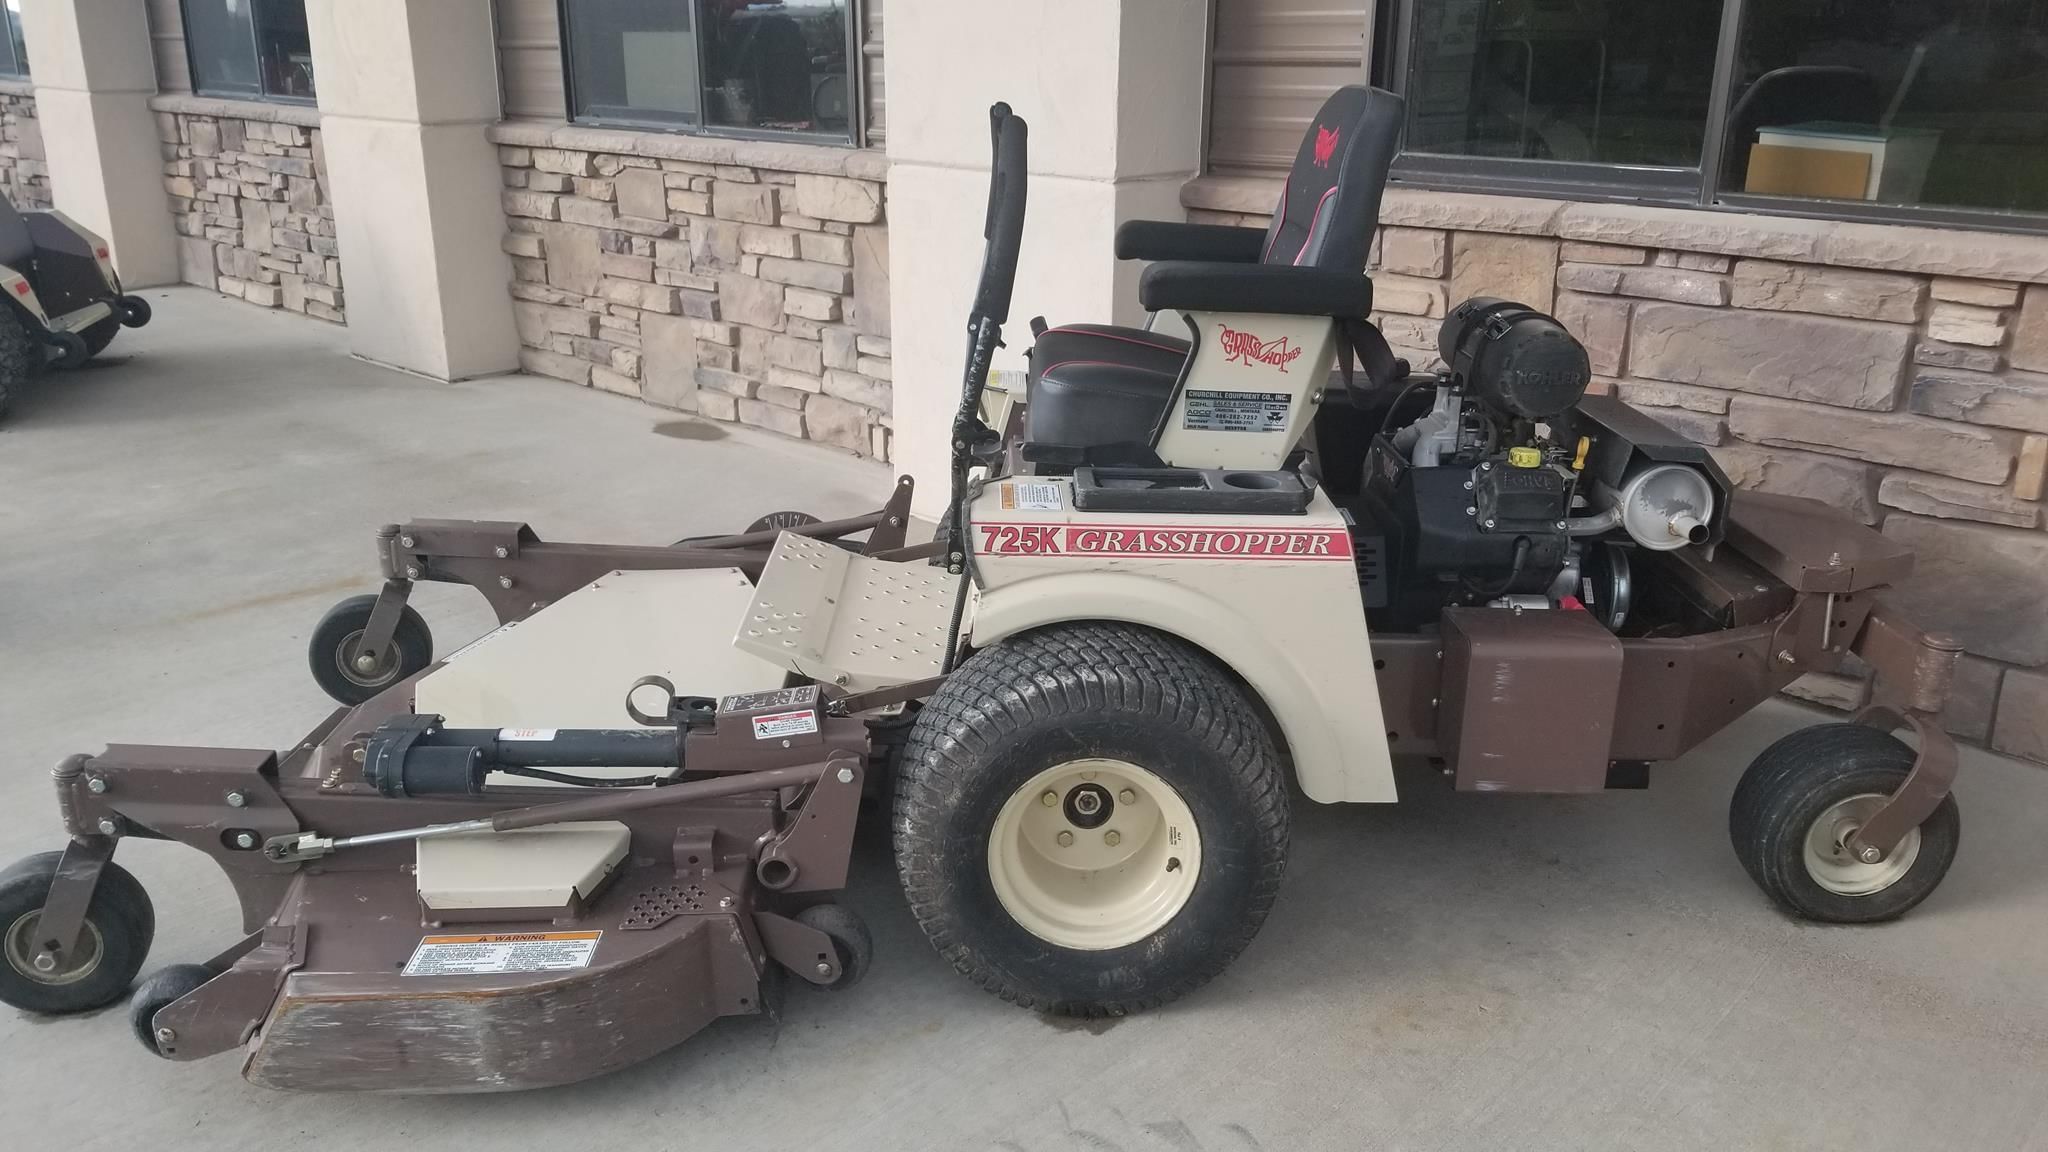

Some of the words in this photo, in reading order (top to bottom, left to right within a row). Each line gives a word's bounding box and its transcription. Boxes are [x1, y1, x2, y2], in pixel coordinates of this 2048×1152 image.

[1514, 368, 1581, 385] KOHLER
[1188, 390, 1223, 399] CHURCHILL
[1224, 392, 1261, 400] EQUIPMENT
[980, 526, 1064, 554] 725K
[1076, 530, 1331, 555] GRASSHOPPER
[494, 934, 546, 942] WARNING
